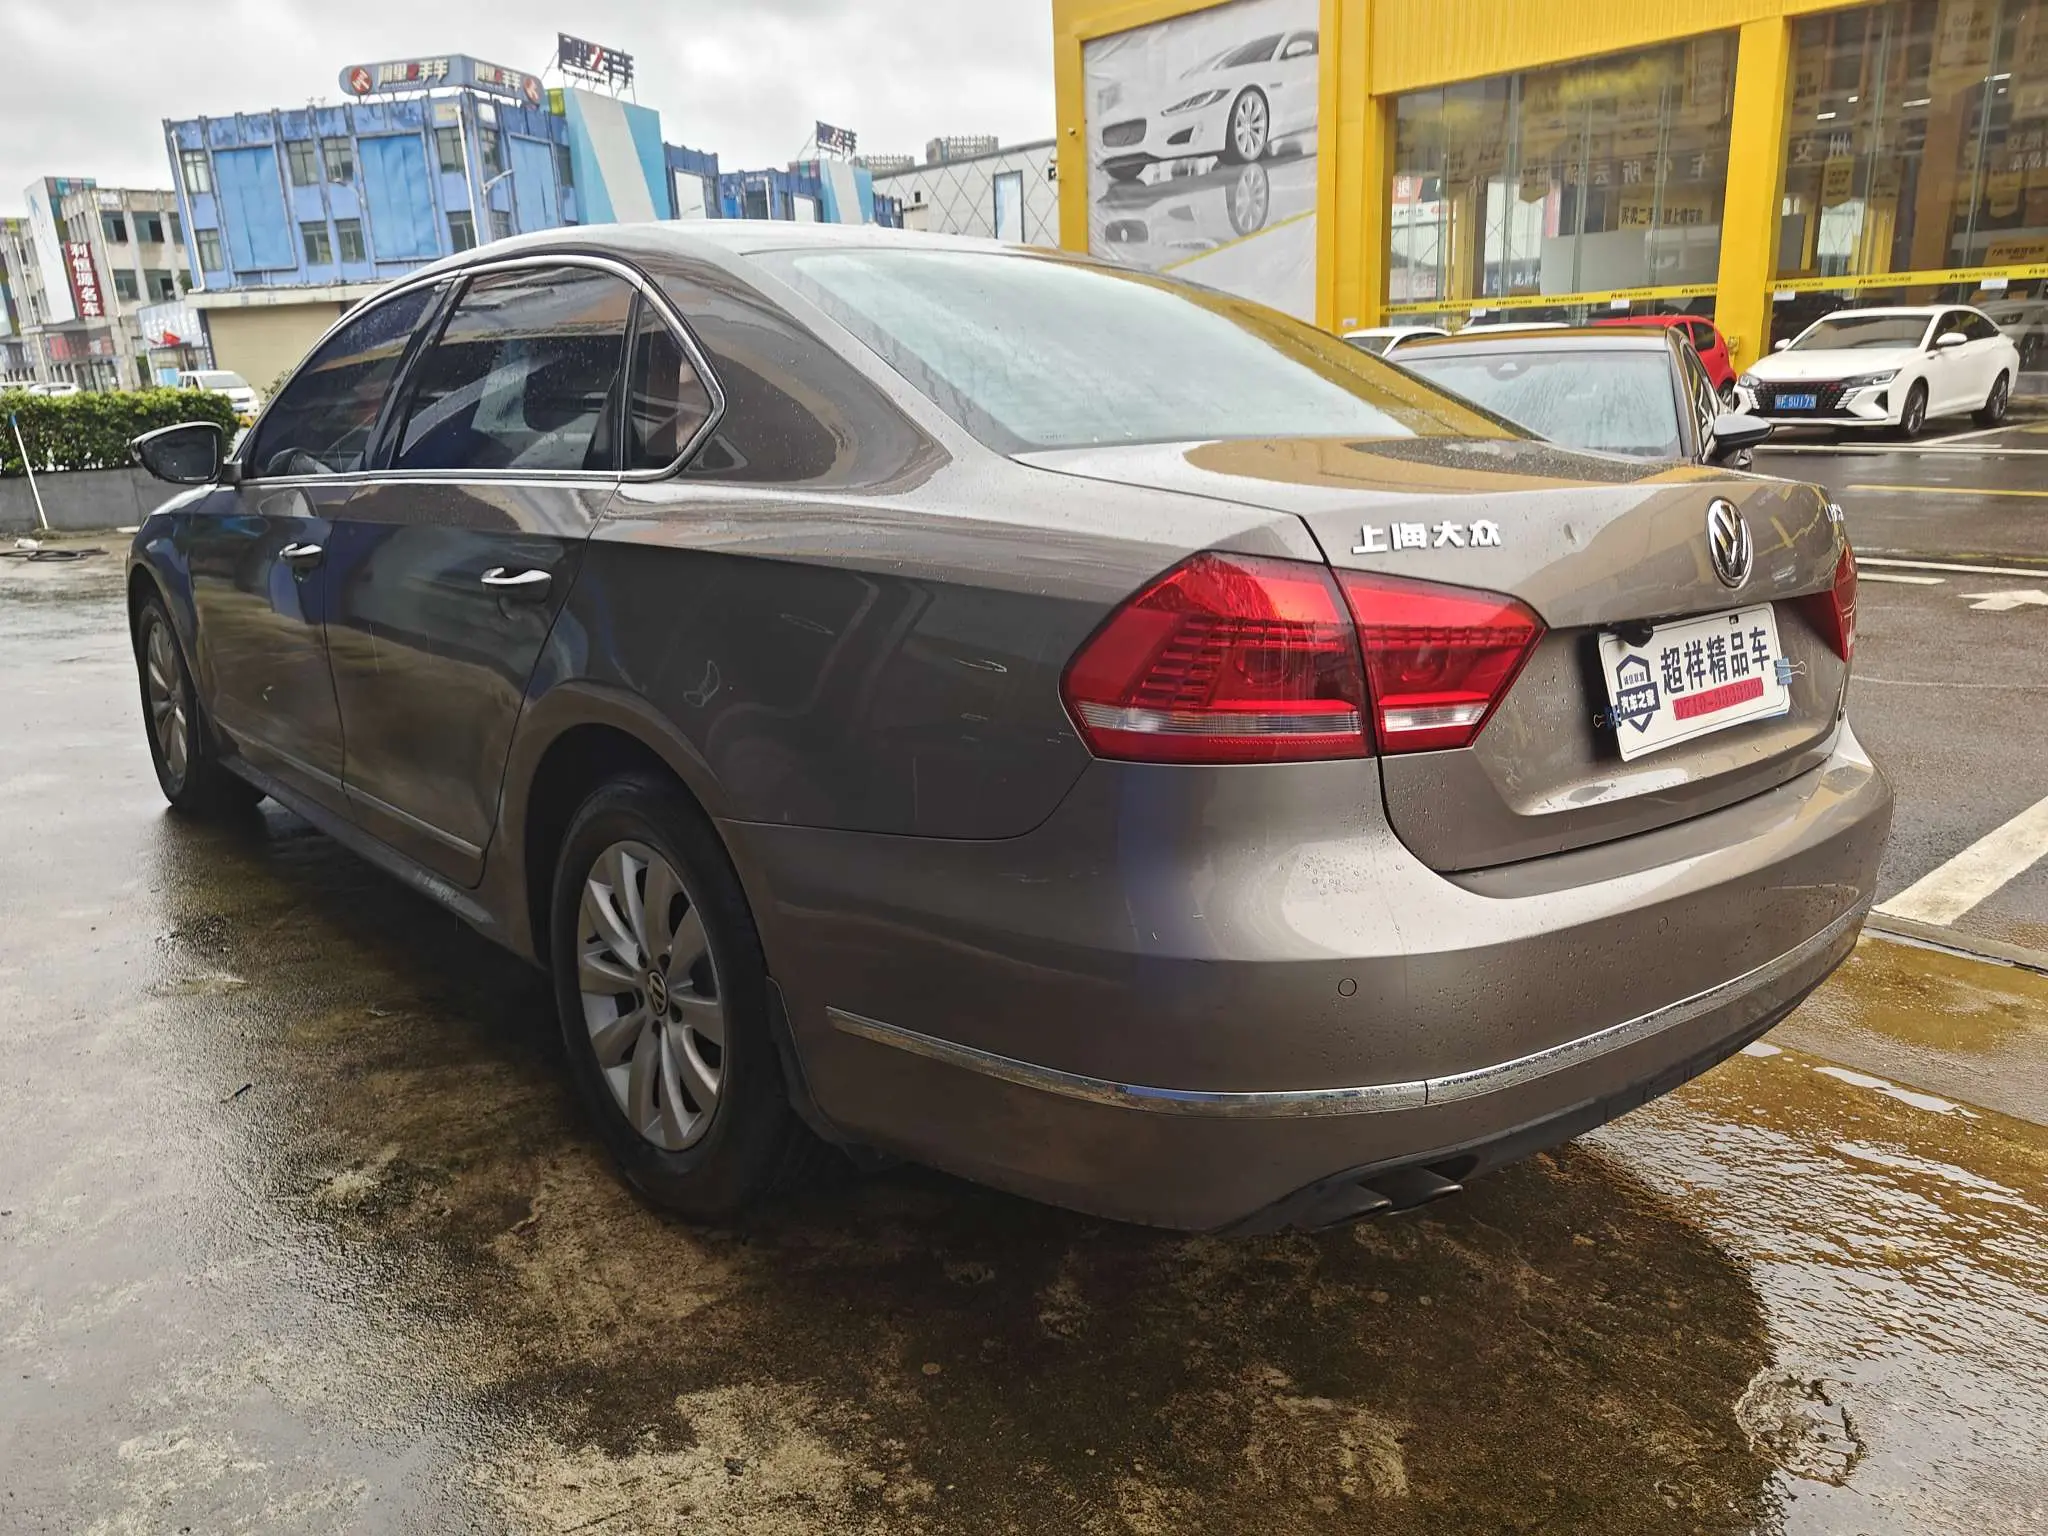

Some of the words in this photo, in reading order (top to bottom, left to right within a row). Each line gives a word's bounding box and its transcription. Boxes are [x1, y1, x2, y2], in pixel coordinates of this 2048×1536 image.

[1351, 518, 1501, 556] 上海大众
[1660, 626, 1770, 696] 超祥精品车
[1620, 689, 1656, 714] 汽车之家
